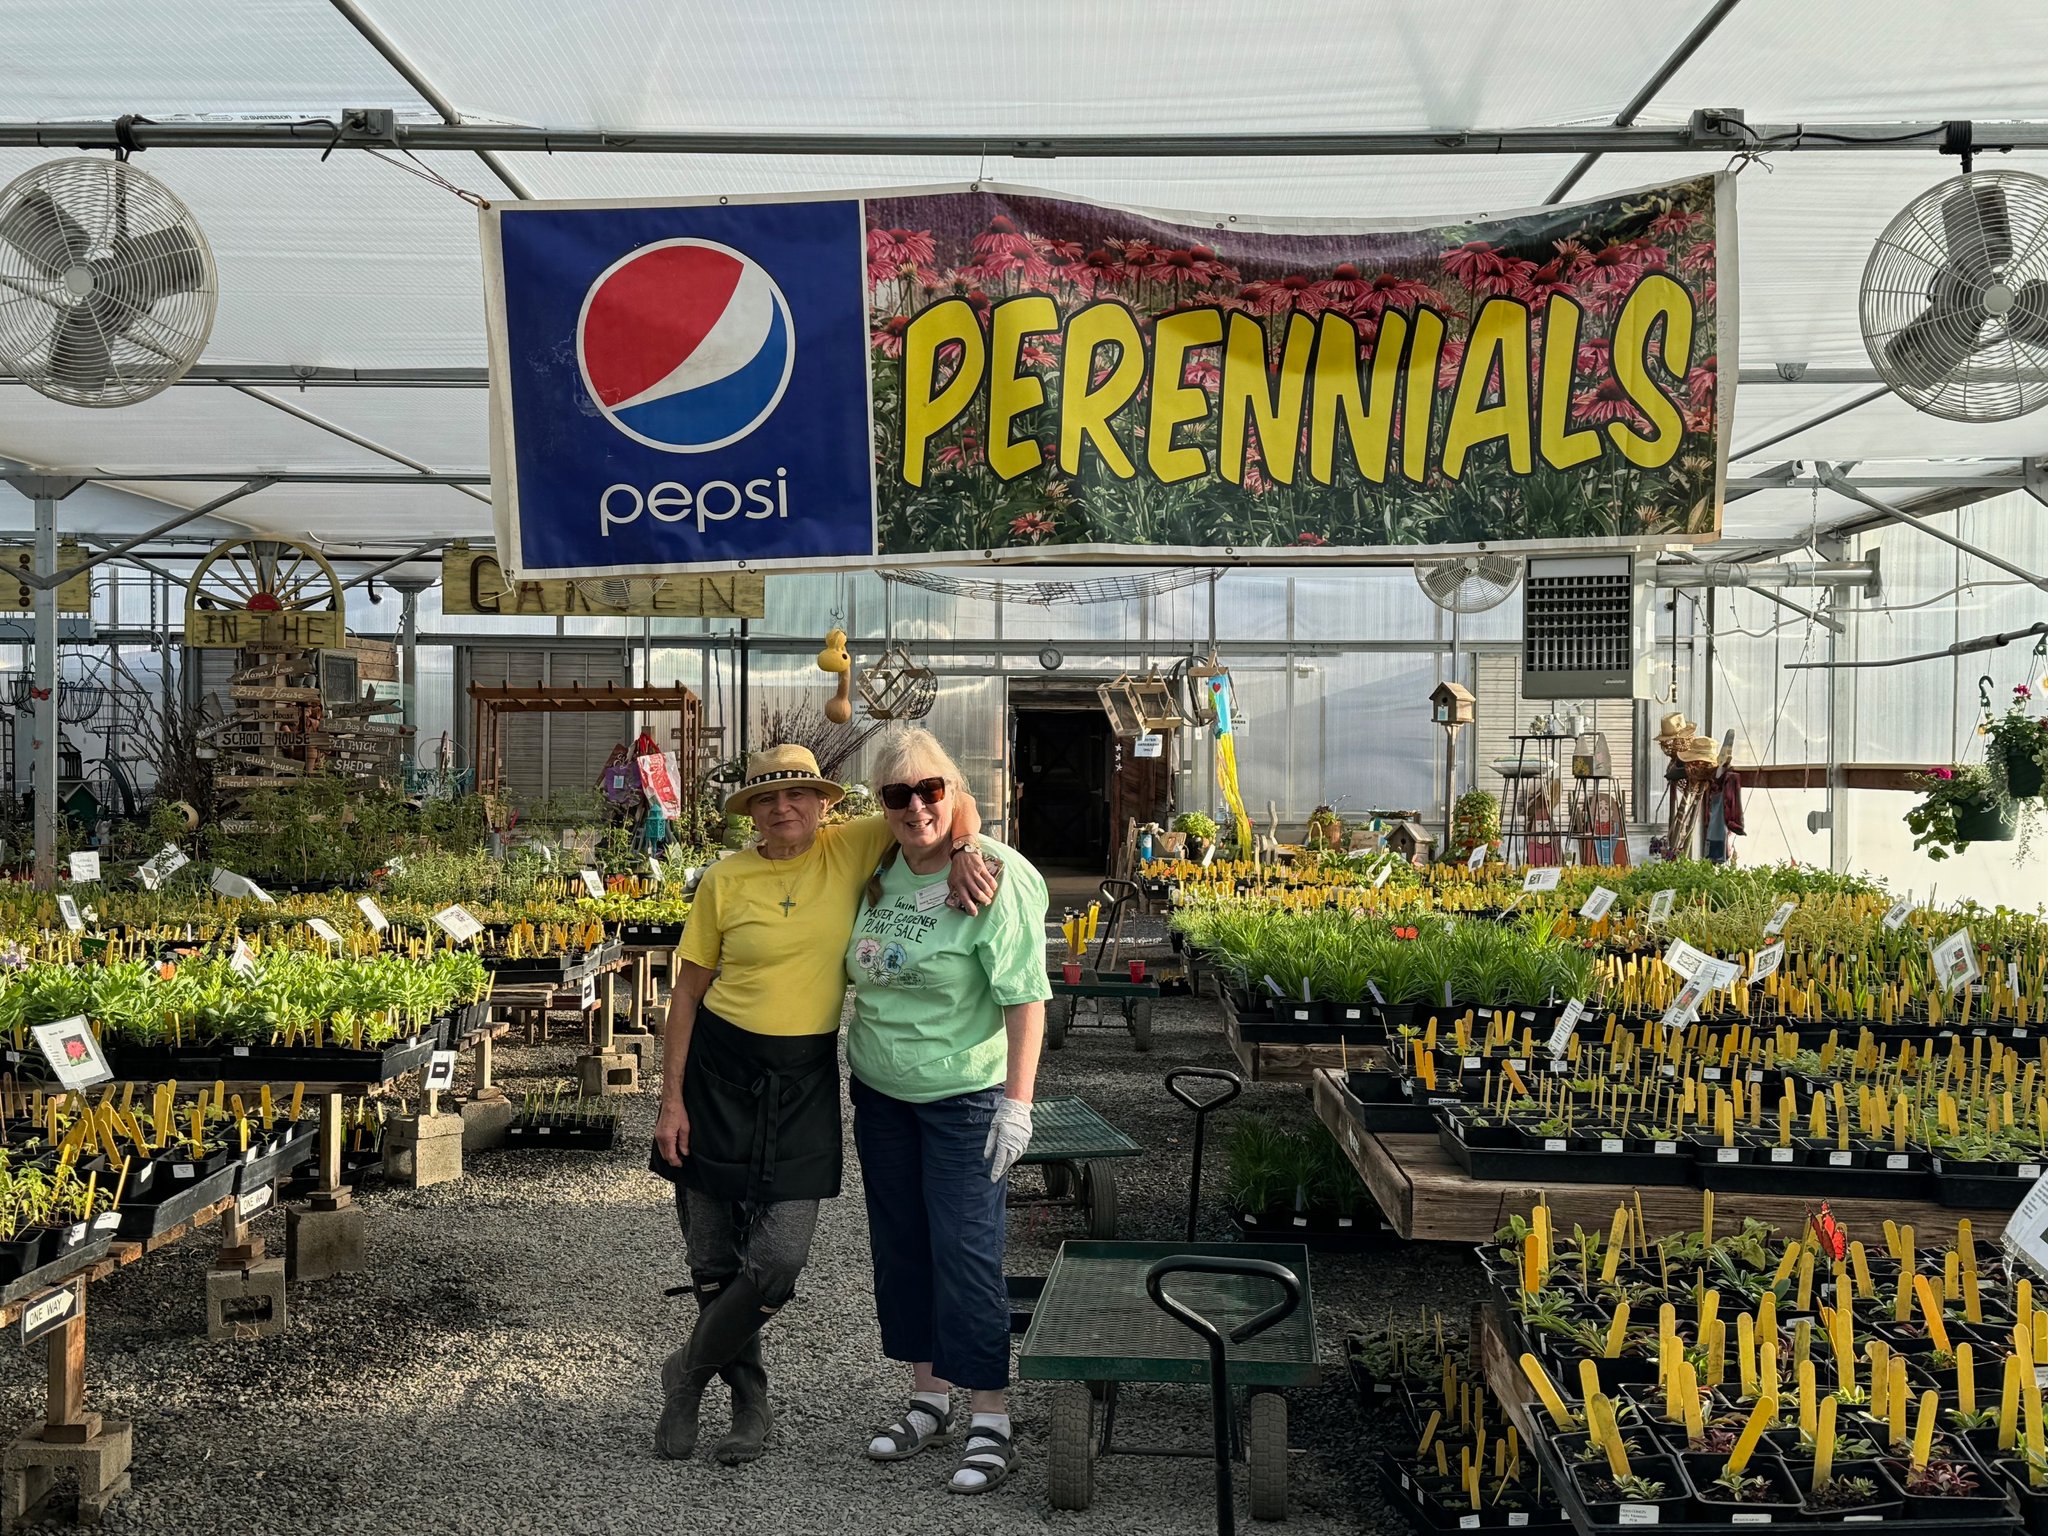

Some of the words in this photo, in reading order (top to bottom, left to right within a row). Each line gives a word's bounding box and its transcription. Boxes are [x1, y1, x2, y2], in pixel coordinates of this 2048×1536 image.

[899, 271, 1697, 489] PERENNIALS
[600, 467, 787, 536] pepsi
[204, 615, 237, 643] IN
[252, 616, 325, 645] THE
[345, 721, 360, 732] Bug
[222, 733, 266, 745] SCHOOL
[274, 733, 310, 745] HOUSE
[245, 756, 266, 767] club
[334, 760, 364, 771] SHED
[894, 896, 919, 913] YAKIM
[864, 908, 894, 920] MASTER
[861, 918, 895, 935] PLANT
[894, 923, 927, 944] SALE
[30, 1307, 43, 1326] ONE
[46, 1296, 63, 1316] WAY
